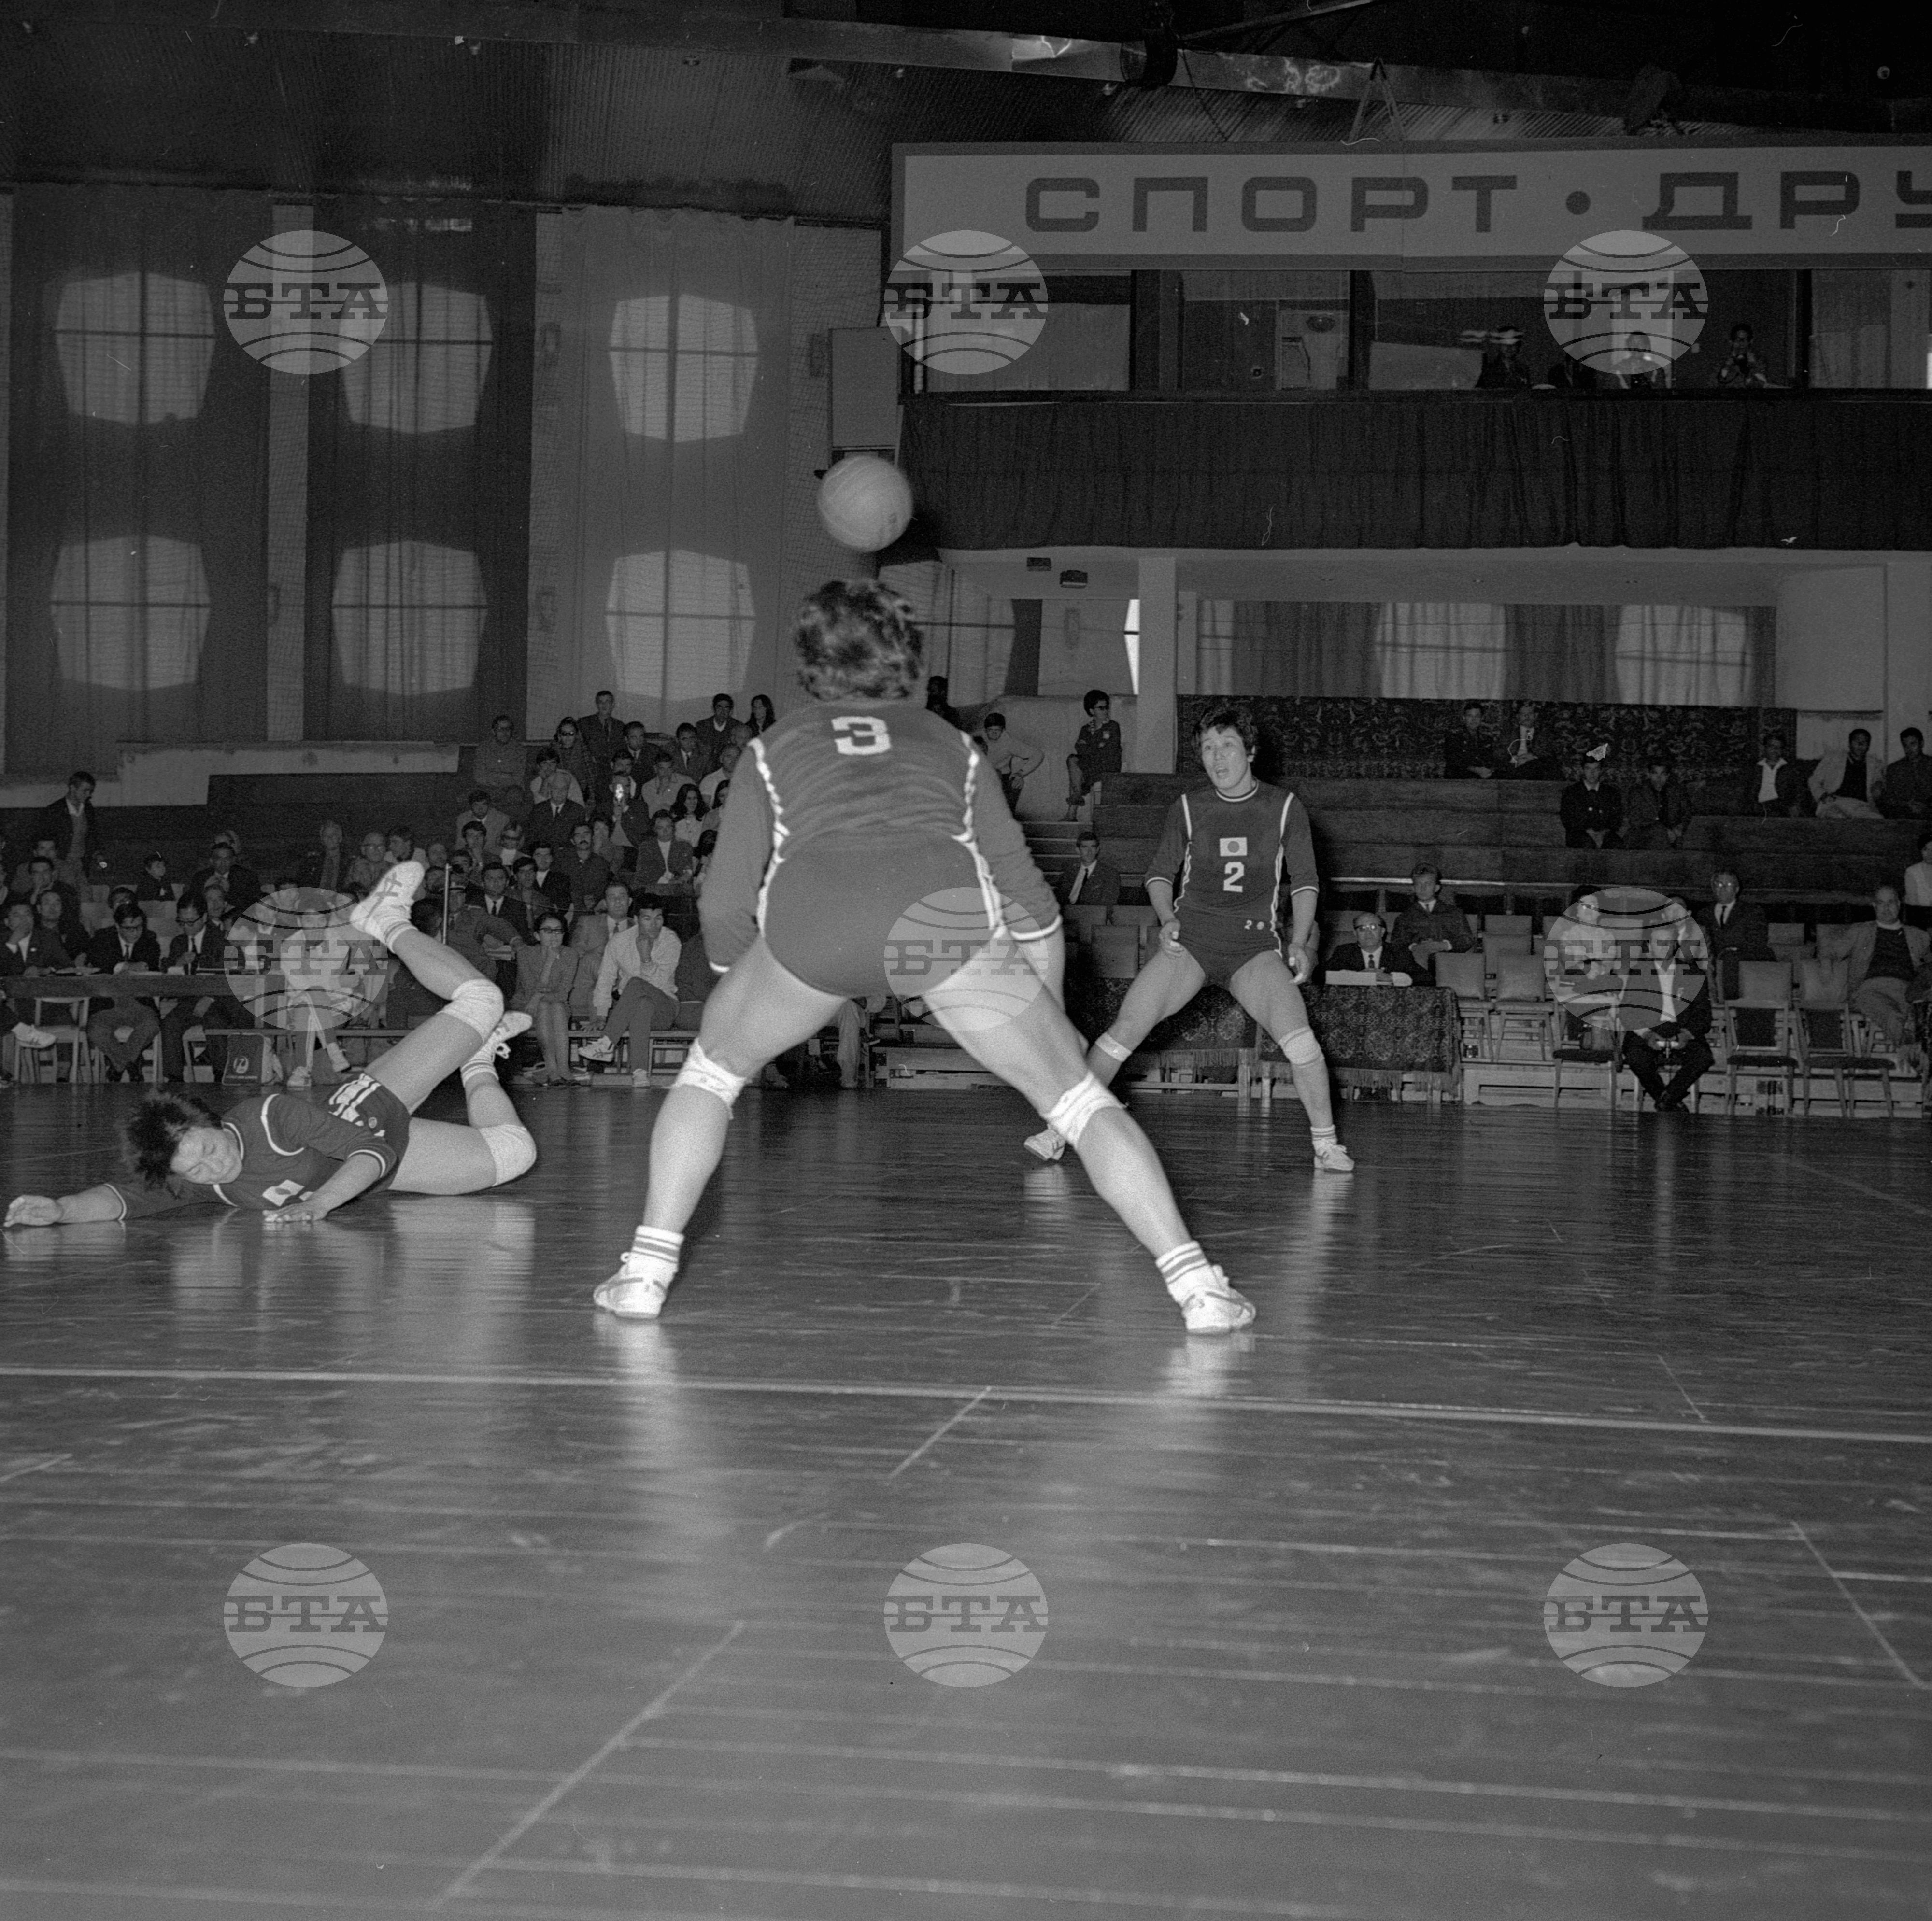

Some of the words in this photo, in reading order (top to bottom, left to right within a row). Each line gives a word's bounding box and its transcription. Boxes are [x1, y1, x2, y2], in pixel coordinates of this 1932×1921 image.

[1025, 175, 1517, 233] СПОРТ
[831, 716, 891, 755] 3
[1223, 862, 1244, 893] 2
[1244, 919, 1252, 930] 2
